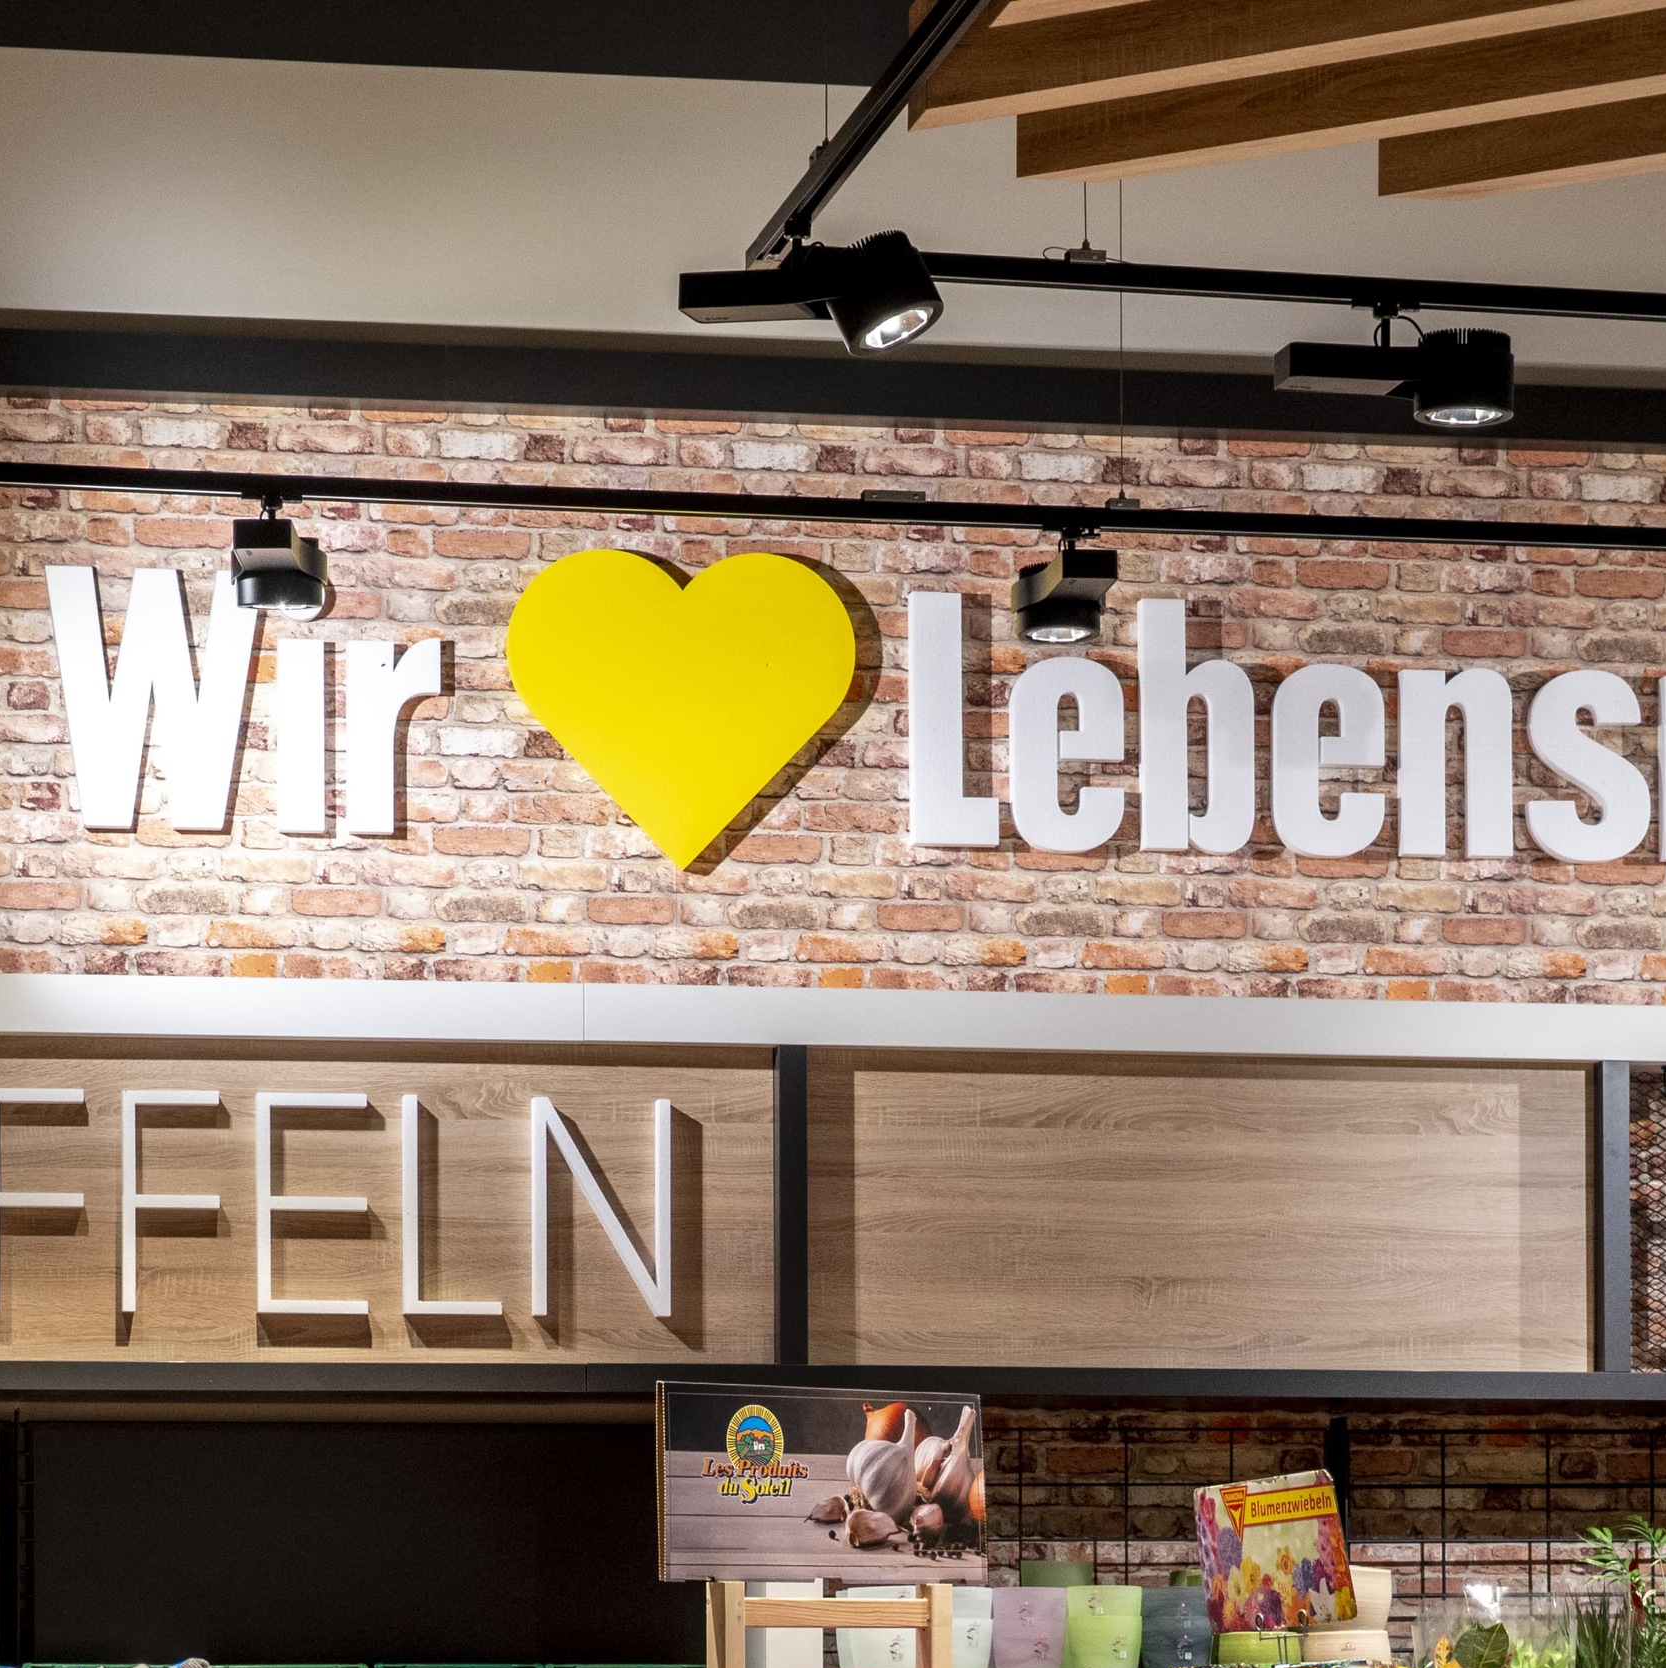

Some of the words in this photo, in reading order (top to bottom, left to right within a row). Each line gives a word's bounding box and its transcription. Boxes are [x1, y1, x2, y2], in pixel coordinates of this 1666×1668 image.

[46, 562, 443, 840] Wir
[701, 1458, 734, 1478] Les
[734, 1458, 809, 1480] Produits
[718, 1480, 739, 1496] du
[739, 1477, 792, 1504] Soleil
[1251, 1492, 1332, 1518] Blumenzwiebeln
